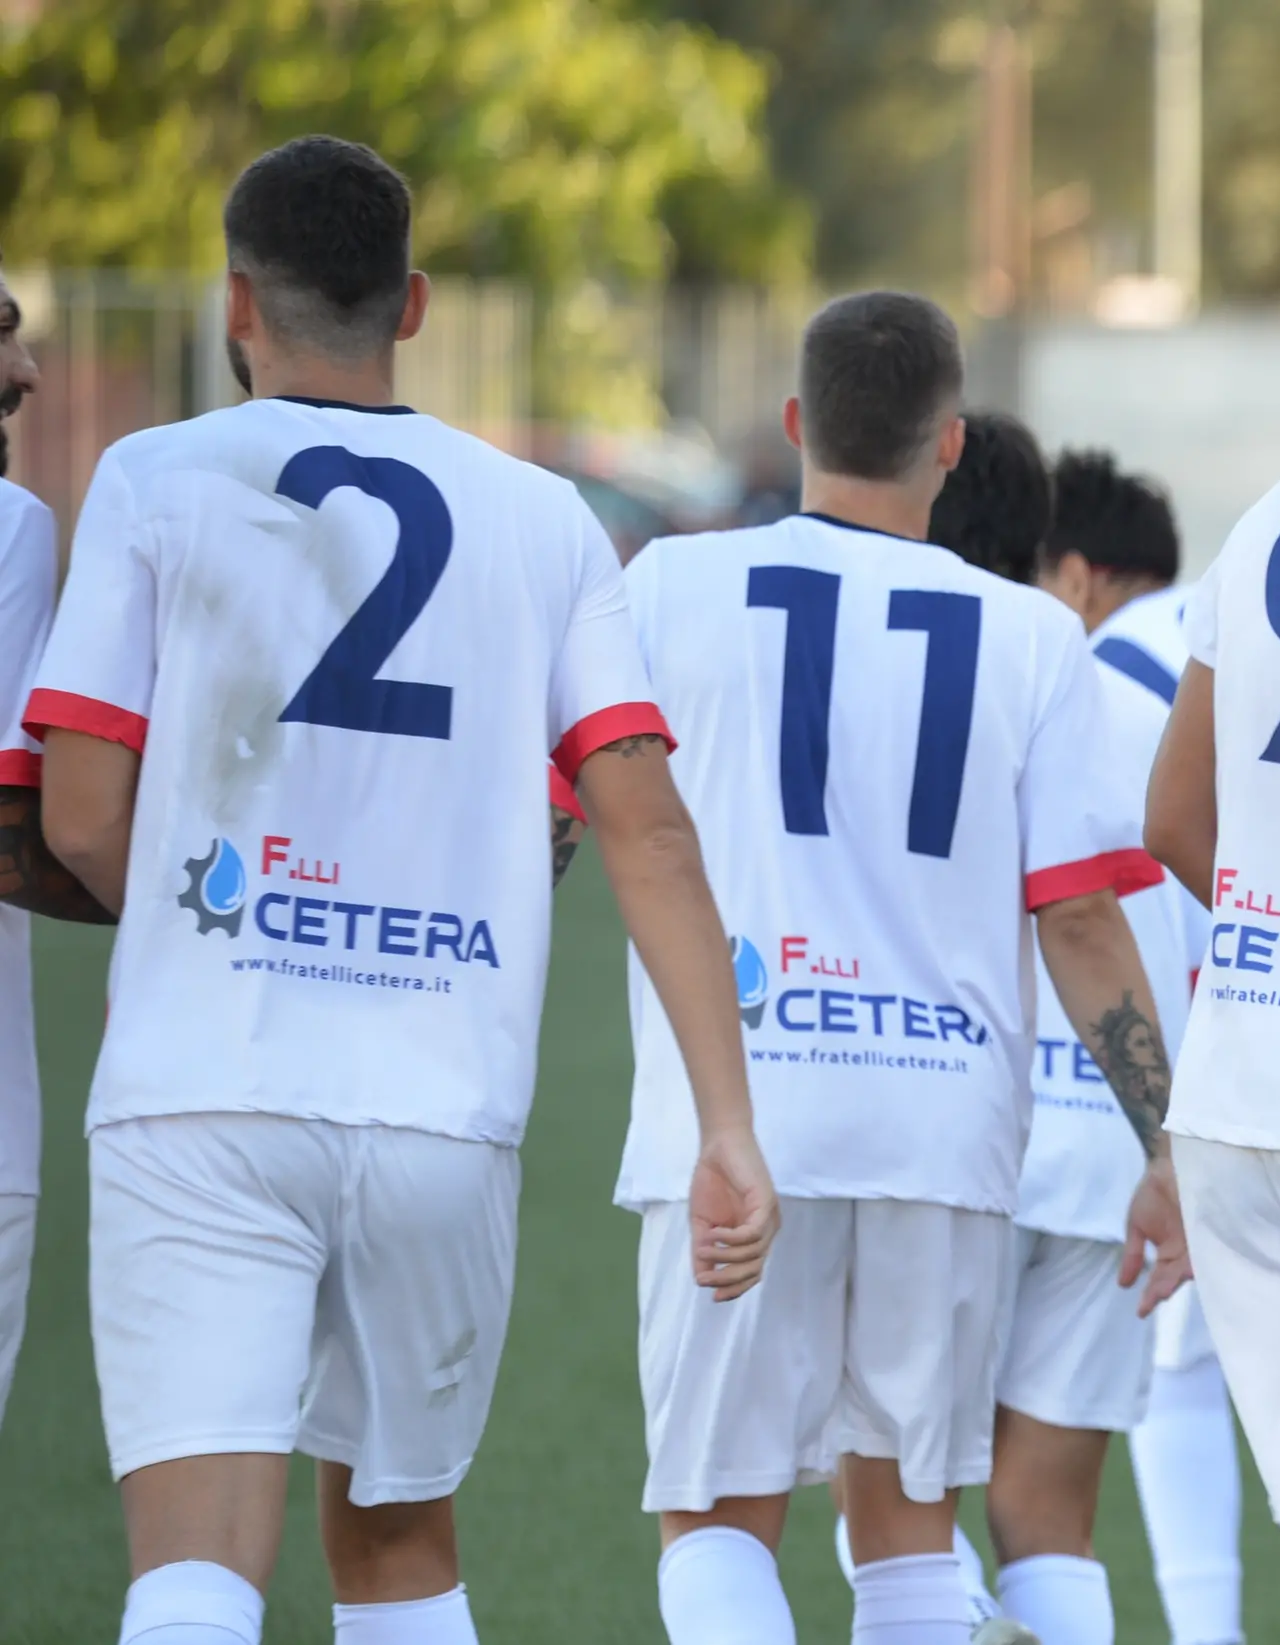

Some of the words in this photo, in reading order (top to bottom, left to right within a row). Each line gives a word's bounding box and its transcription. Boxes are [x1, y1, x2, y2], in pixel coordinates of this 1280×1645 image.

[276, 445, 454, 740] 2
[746, 565, 982, 859] 11
[254, 892, 502, 970] CETERA
[230, 958, 453, 994] www.fratellicetera.it
[750, 1048, 969, 1074] www.fratellicetera.it
